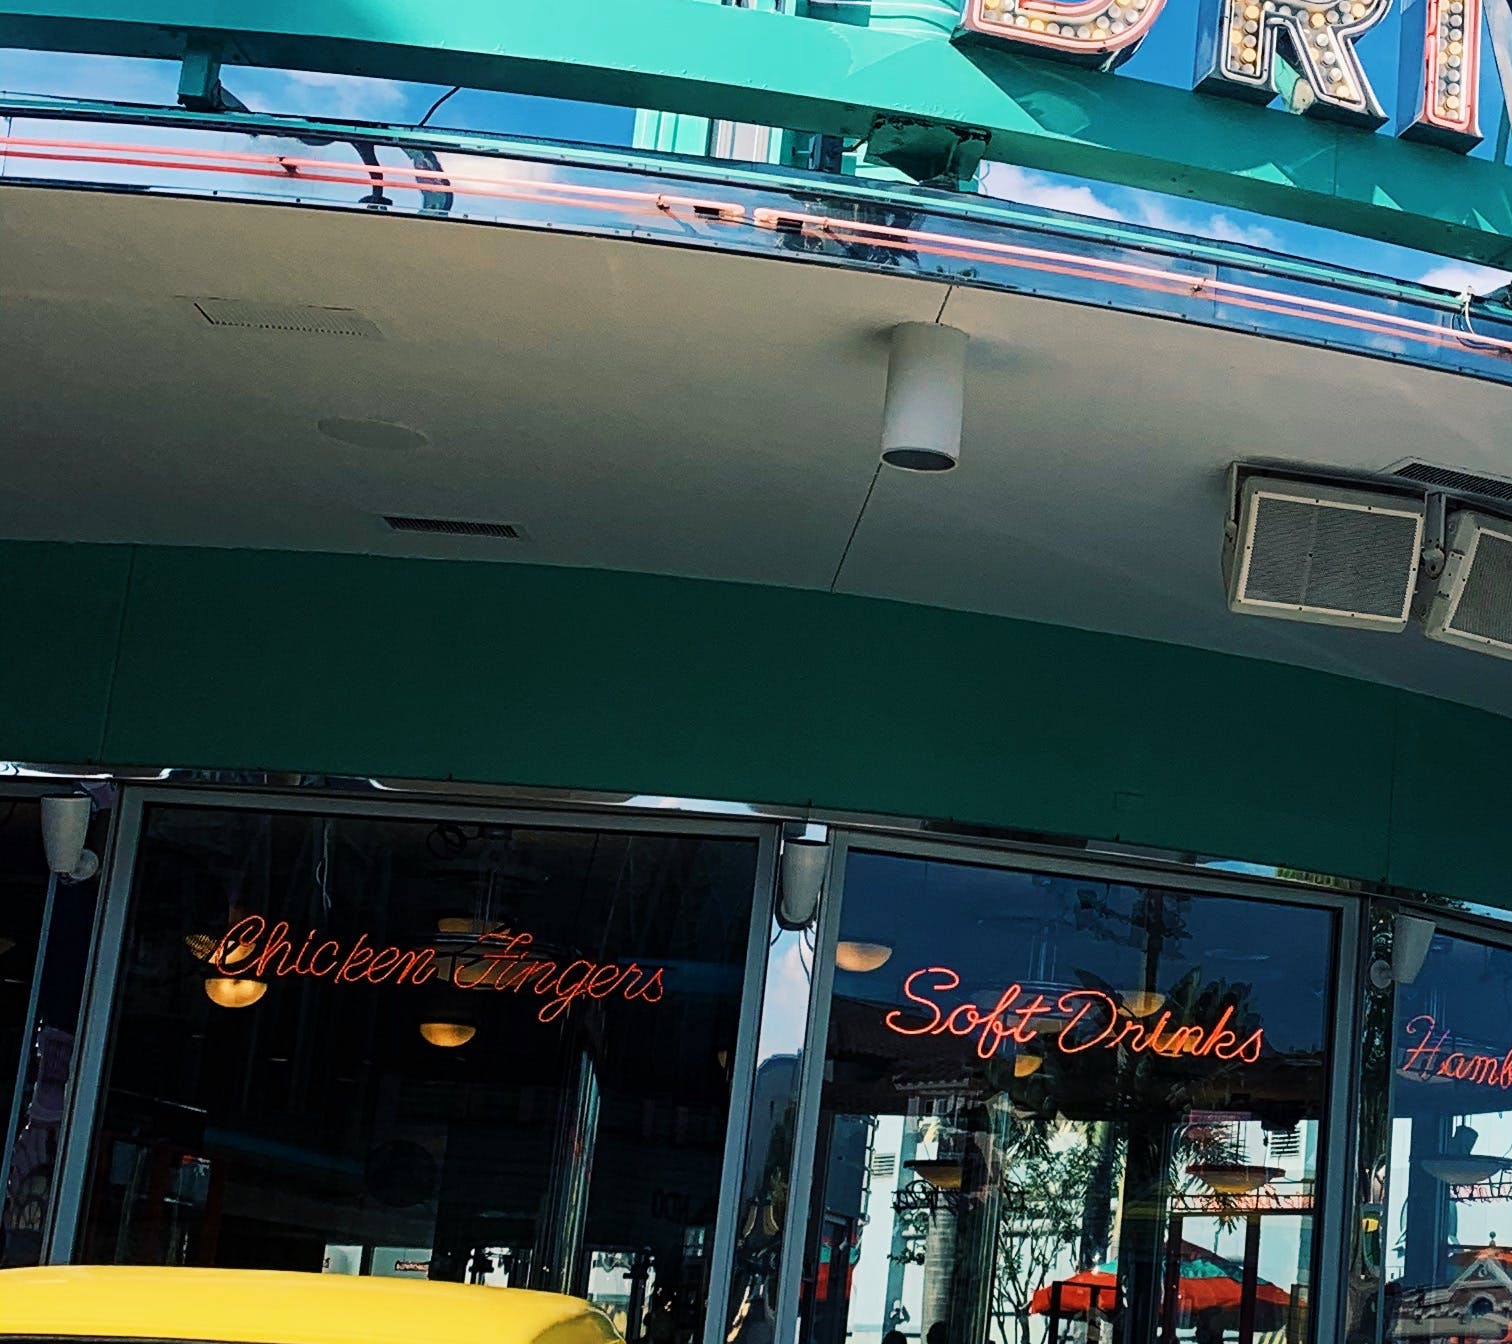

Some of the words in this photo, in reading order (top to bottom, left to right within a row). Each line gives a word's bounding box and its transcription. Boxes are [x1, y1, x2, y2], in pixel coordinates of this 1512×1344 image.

[215, 914, 437, 986] Chicken
[453, 931, 665, 1023] Fingers
[885, 966, 1052, 1059] Soft
[1058, 989, 1264, 1064] Drinks
